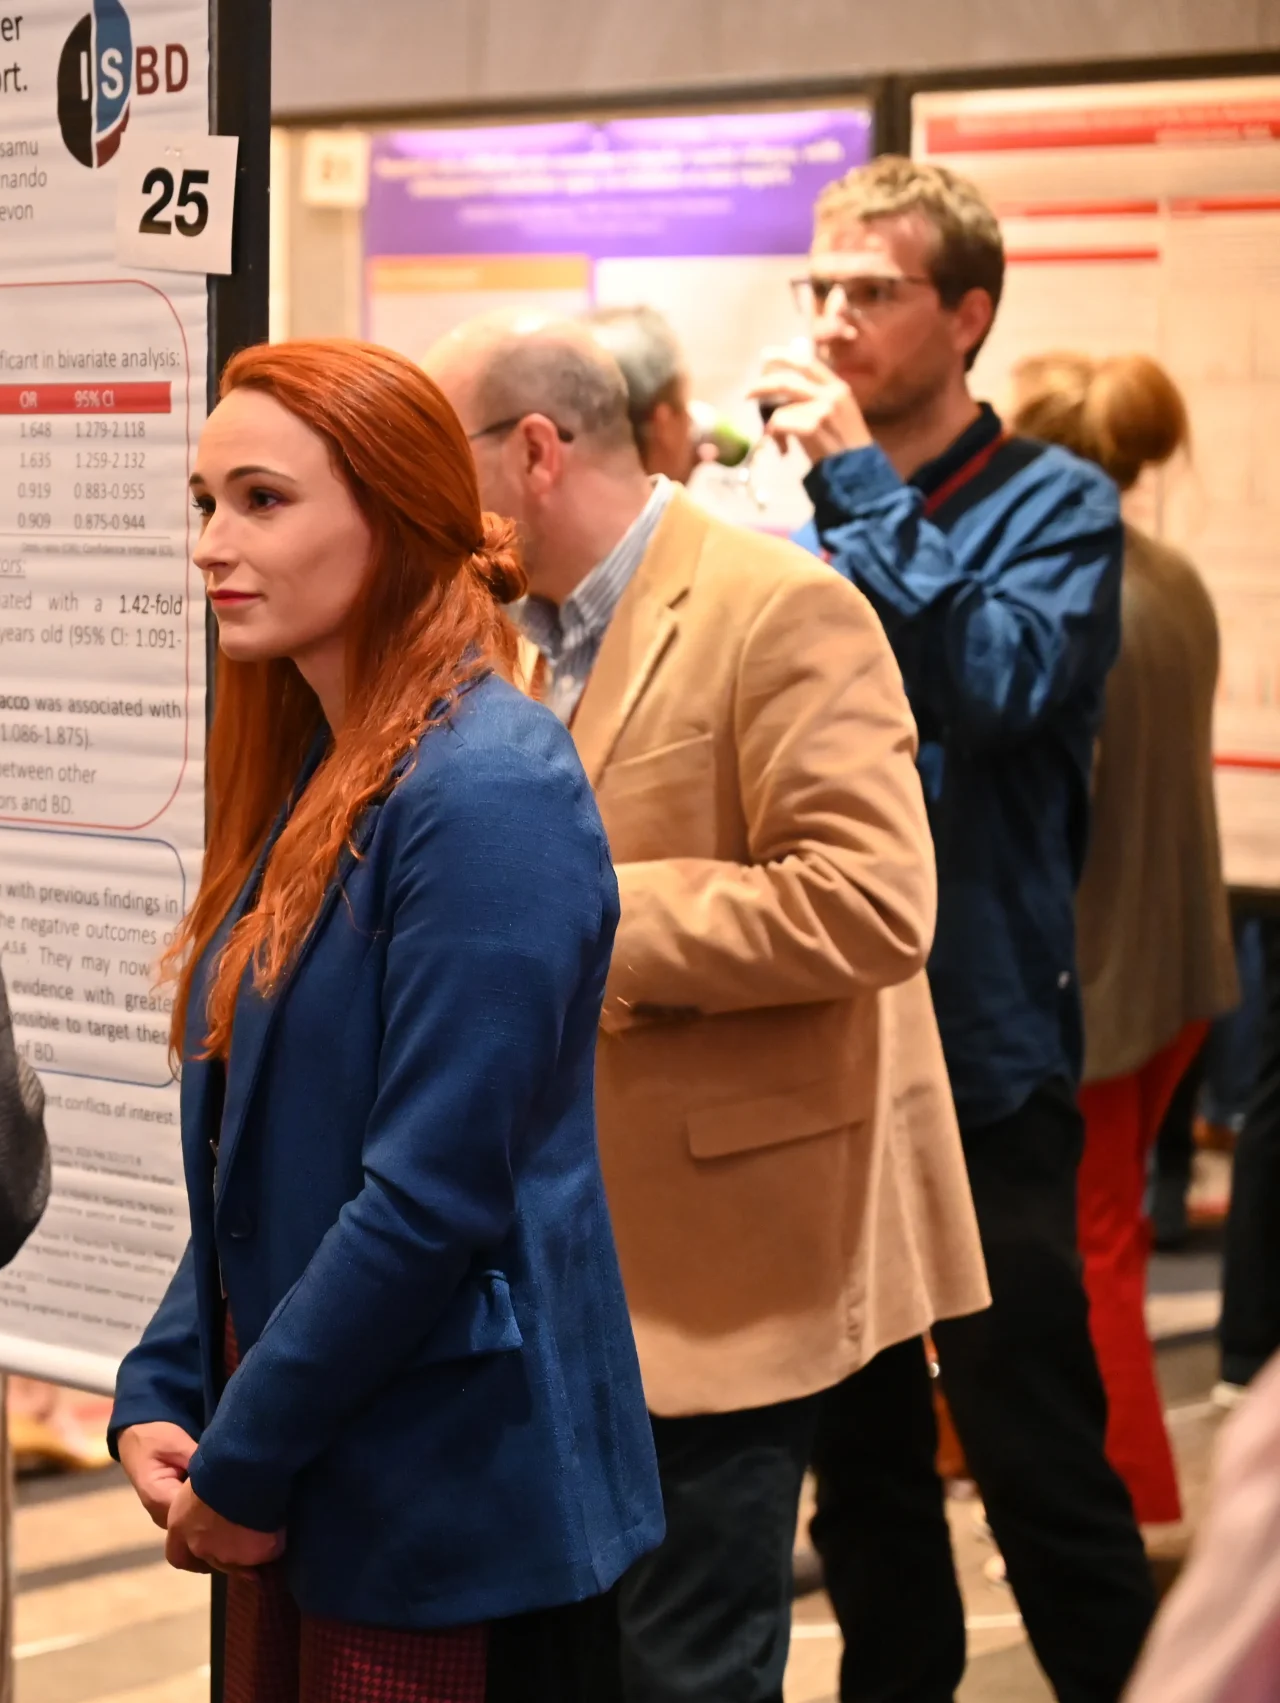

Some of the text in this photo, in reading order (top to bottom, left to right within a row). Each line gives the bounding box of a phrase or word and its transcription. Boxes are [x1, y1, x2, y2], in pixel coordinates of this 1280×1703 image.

[80, 44, 189, 101] ISBD
[139, 167, 210, 237] 25
[43, 351, 54, 369] in
[58, 348, 117, 369] bivariate
[121, 346, 181, 371] analysis:
[20, 390, 37, 409] OR
[74, 389, 101, 408] 95%
[103, 390, 115, 407] CI
[20, 421, 52, 438] 1.648
[75, 421, 146, 438] 1.279-2.118
[20, 452, 52, 469] 1.635
[75, 452, 145, 469] 1.259-2.132
[18, 482, 52, 499] 0.919
[74, 482, 145, 500] 0.883-0.955
[18, 512, 52, 529] 0.909
[74, 513, 146, 530] 0.875-0.944
[48, 591, 79, 613] with
[94, 597, 103, 613] a
[119, 593, 183, 616] 1.42-fold
[41, 624, 63, 645] old
[69, 625, 105, 647] (95%
[111, 627, 129, 647] CI:
[136, 628, 182, 649] 1.091-
[35, 695, 63, 713] was
[68, 697, 143, 718] associated
[149, 701, 182, 719] with
[0, 721, 93, 750] 1.086-1.875).
[57, 763, 97, 785] other
[21, 794, 48, 814] and
[51, 796, 74, 815] BD.
[6, 880, 35, 900] with
[40, 886, 100, 907] previous
[103, 887, 161, 917] findings
[165, 895, 178, 914] in
[21, 915, 80, 939] negative
[85, 924, 157, 946] outcomes
[39, 945, 73, 973] They
[81, 954, 111, 979] may
[119, 959, 151, 977] now
[12, 977, 172, 1014] evidence with greate
[12, 1011, 168, 1046] ossible to target thes
[17, 1042, 59, 1064] of BD.
[65, 1096, 111, 1117] conflicts
[114, 1102, 126, 1118] of
[128, 1105, 178, 1126] interest.
